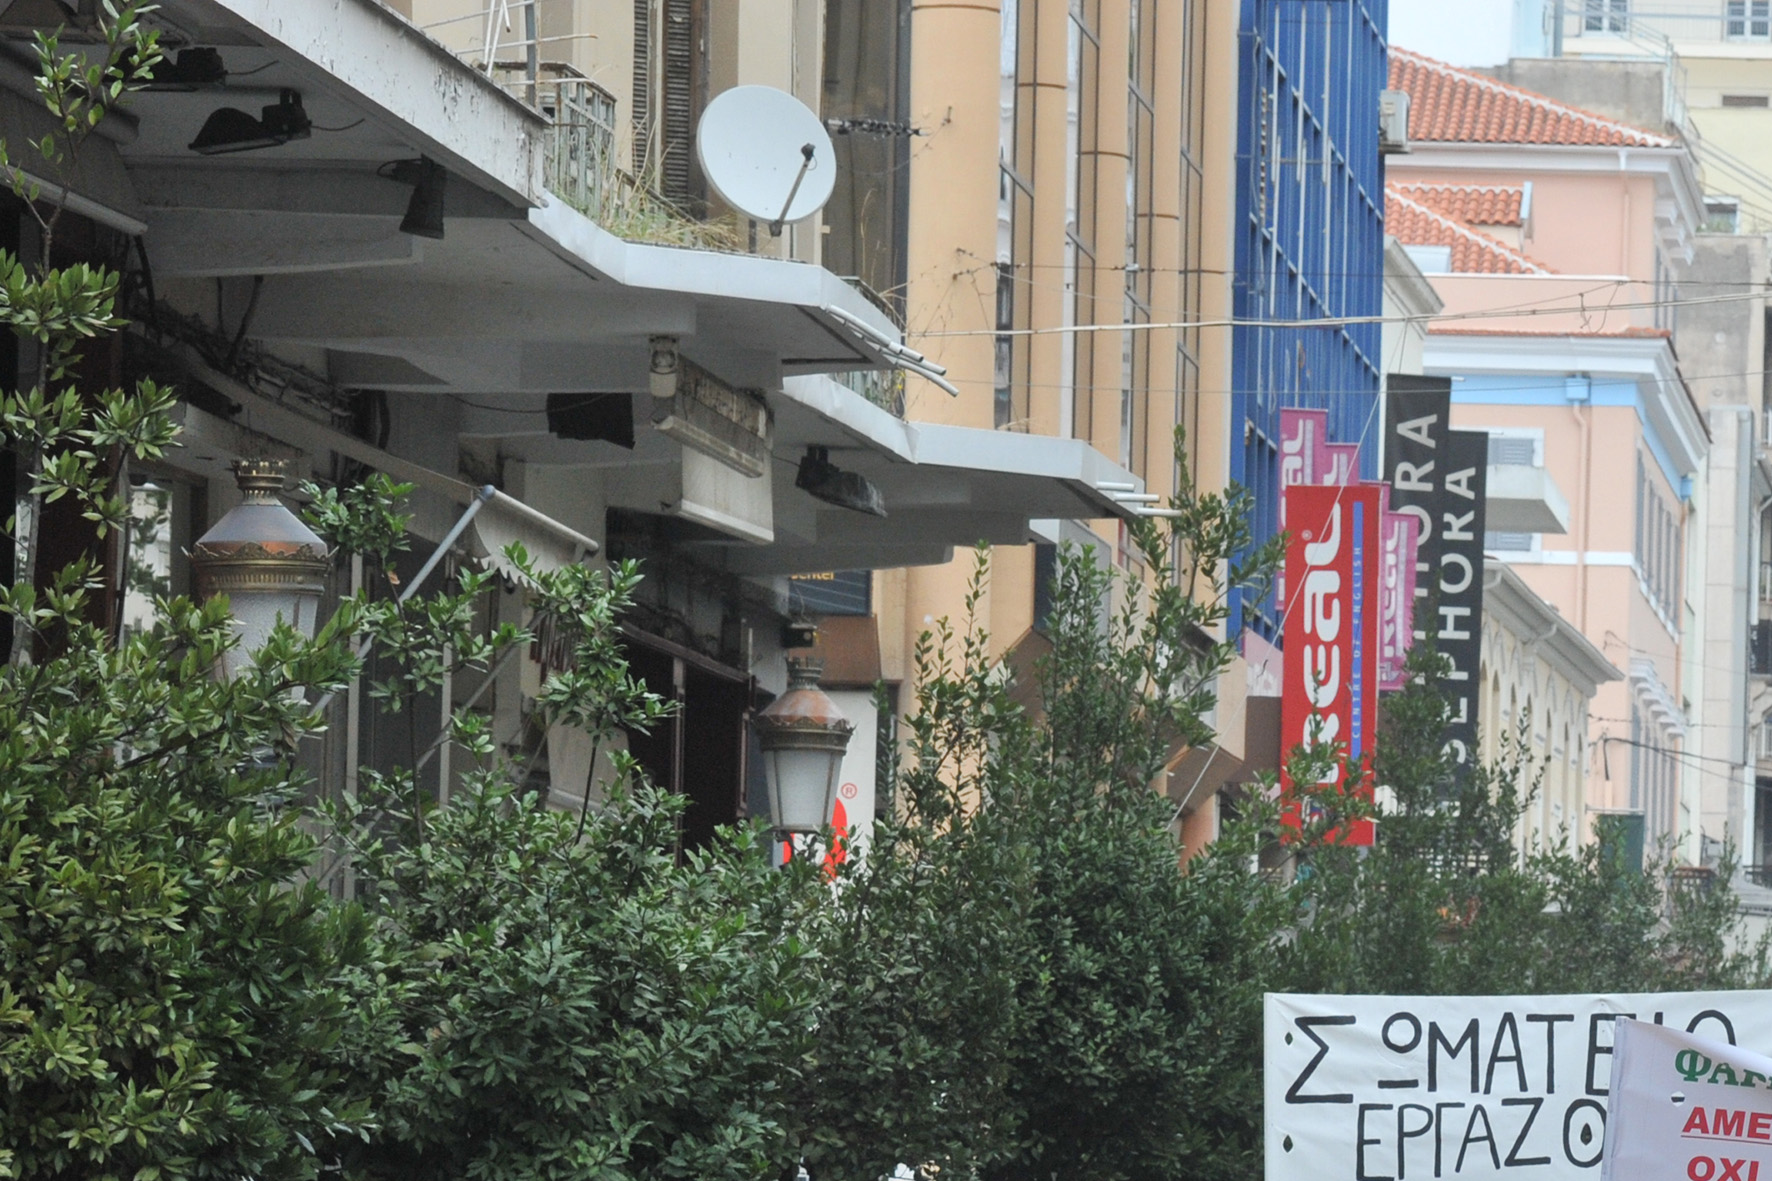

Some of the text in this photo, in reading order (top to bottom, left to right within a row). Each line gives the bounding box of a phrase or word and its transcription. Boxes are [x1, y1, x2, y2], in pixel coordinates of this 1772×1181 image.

[1352, 546, 1361, 624] ENGLISH
[1352, 672, 1361, 739] CENTRE
[1285, 1009, 1737, 1103] ΣΩΜΑΤΕ
